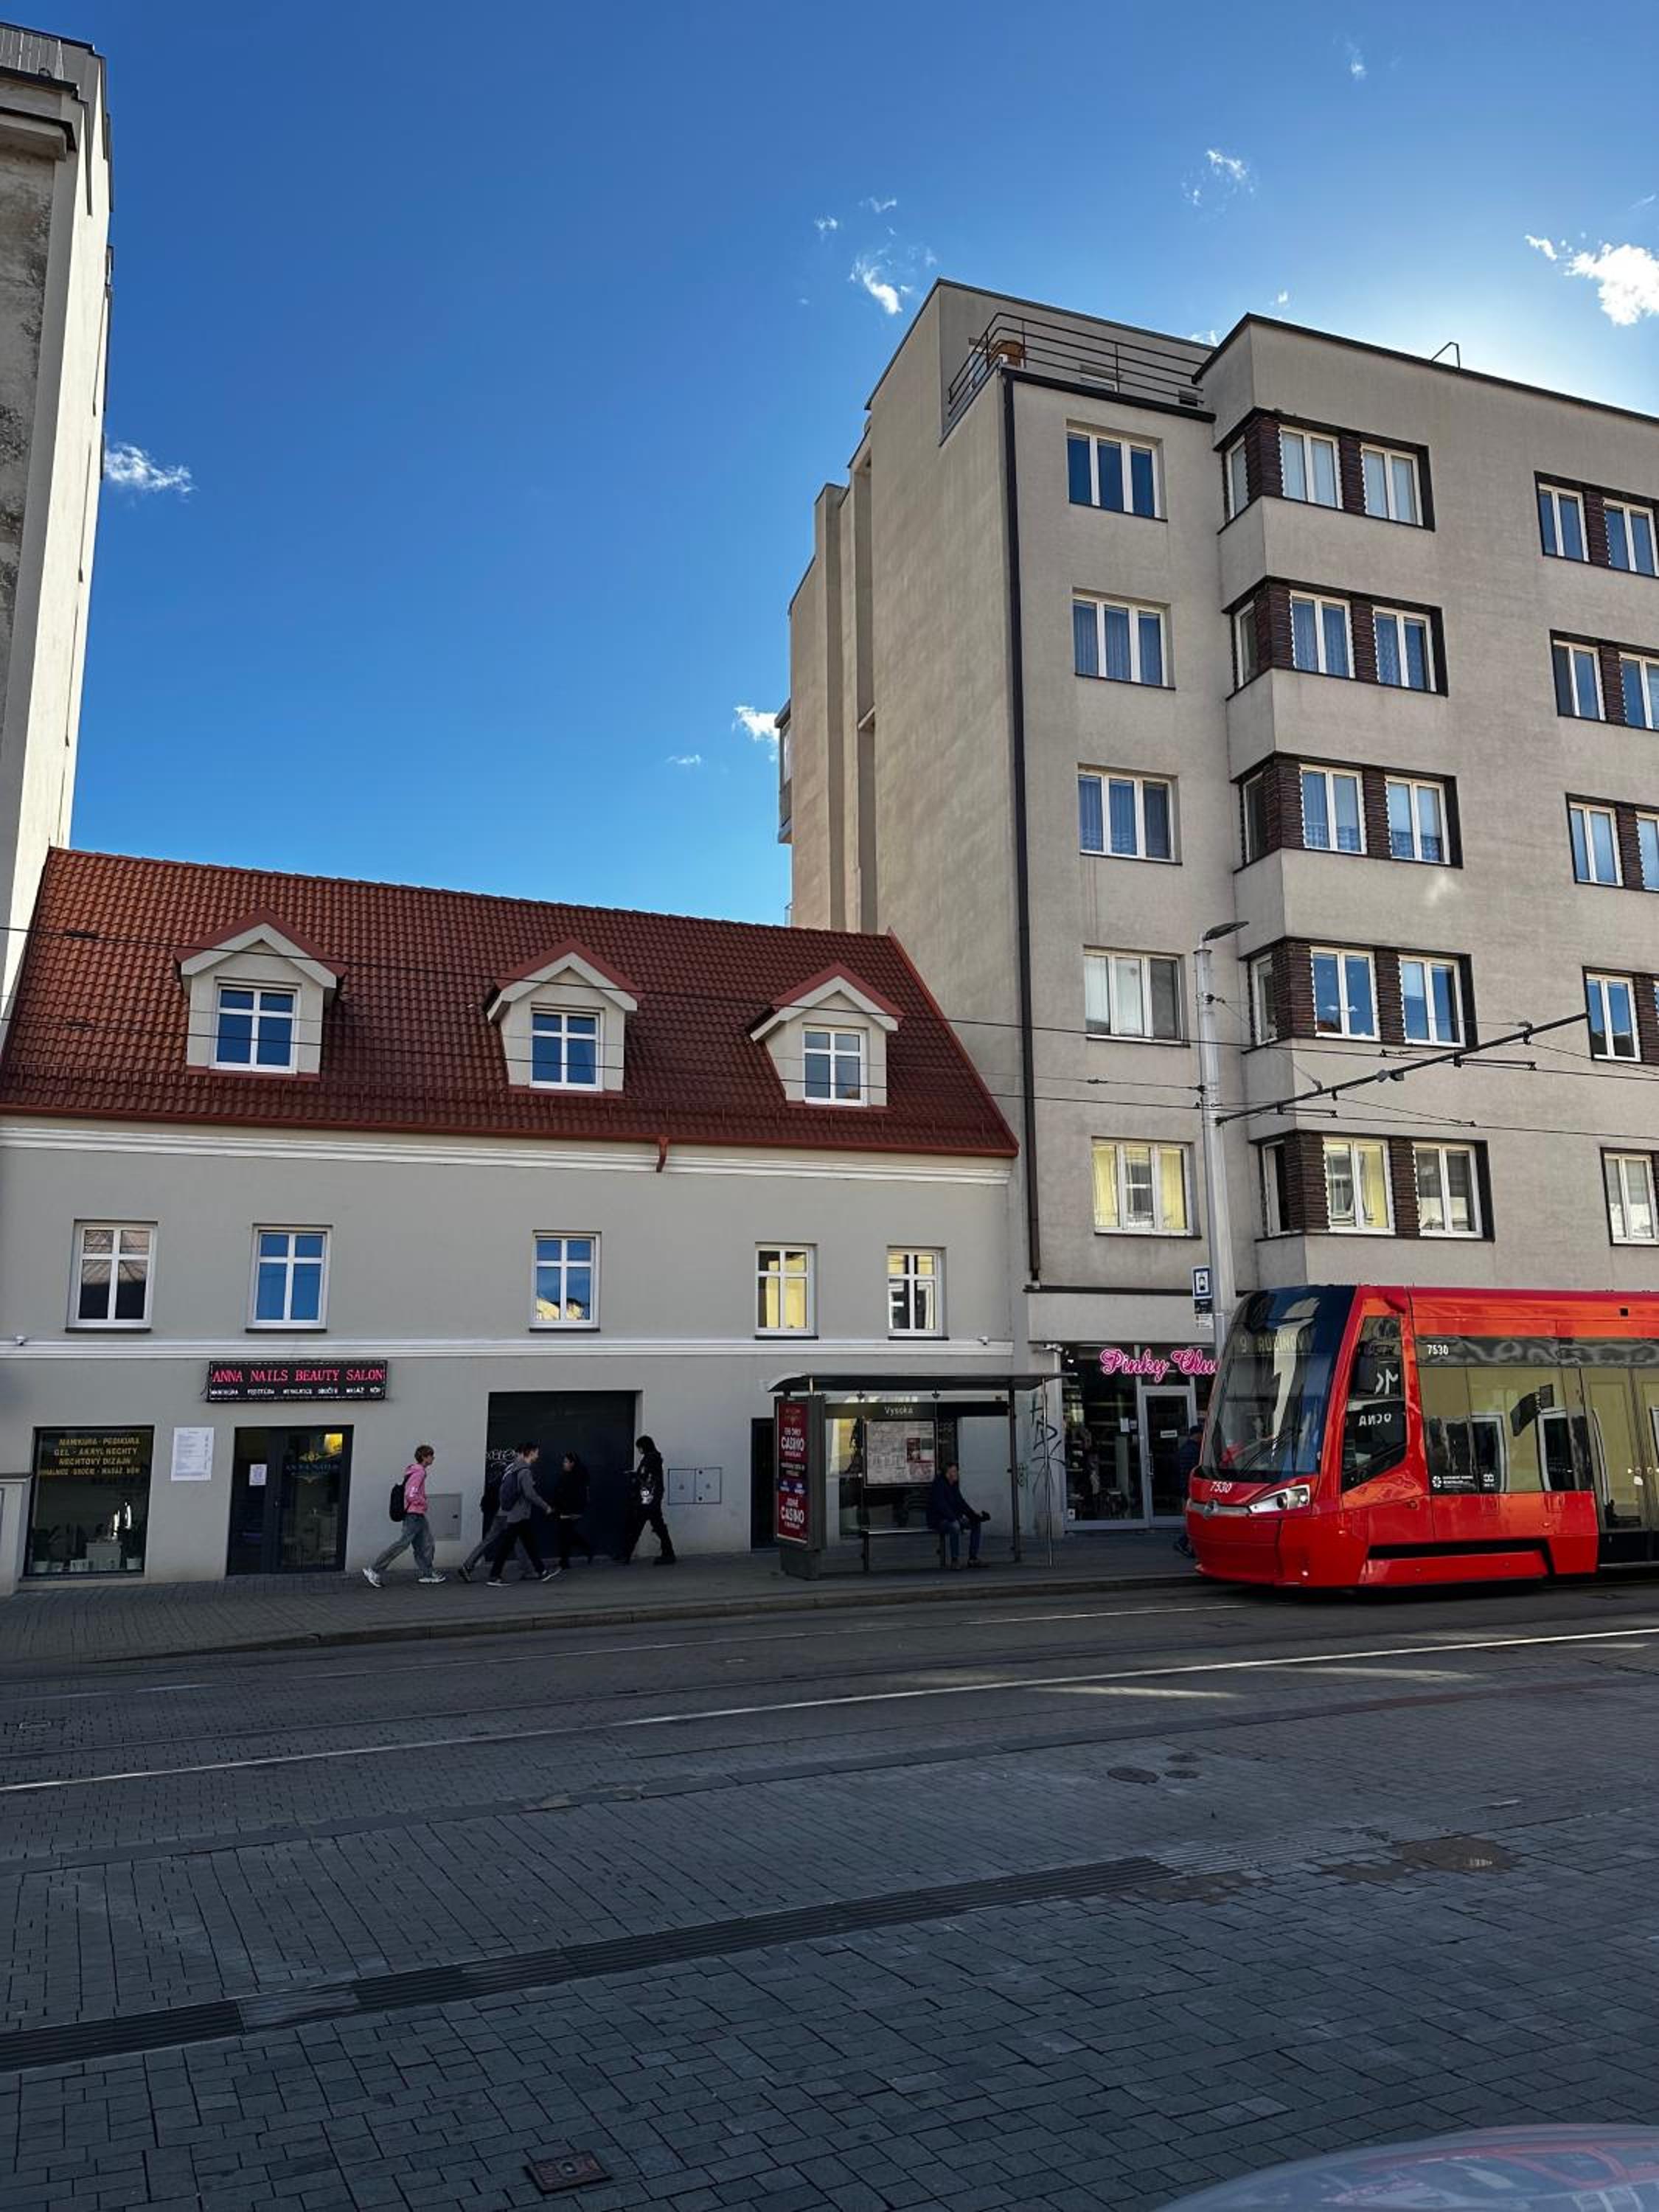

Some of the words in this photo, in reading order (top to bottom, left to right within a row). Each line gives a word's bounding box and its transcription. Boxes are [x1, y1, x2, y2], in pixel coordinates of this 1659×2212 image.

[1240, 1335, 1247, 1352] 9
[1427, 1344, 1449, 1355] 7530
[1099, 1348, 1169, 1384] Pinky
[1170, 1349, 1217, 1375] Clu
[212, 1369, 243, 1382] ANNA
[251, 1369, 288, 1382] NAILS
[295, 1369, 339, 1381] BEAUTY
[346, 1369, 383, 1382] SALON
[106, 1447, 138, 1455] NECHTY
[1209, 1481, 1232, 1493] 7530
[780, 1506, 804, 1524] CASINO
